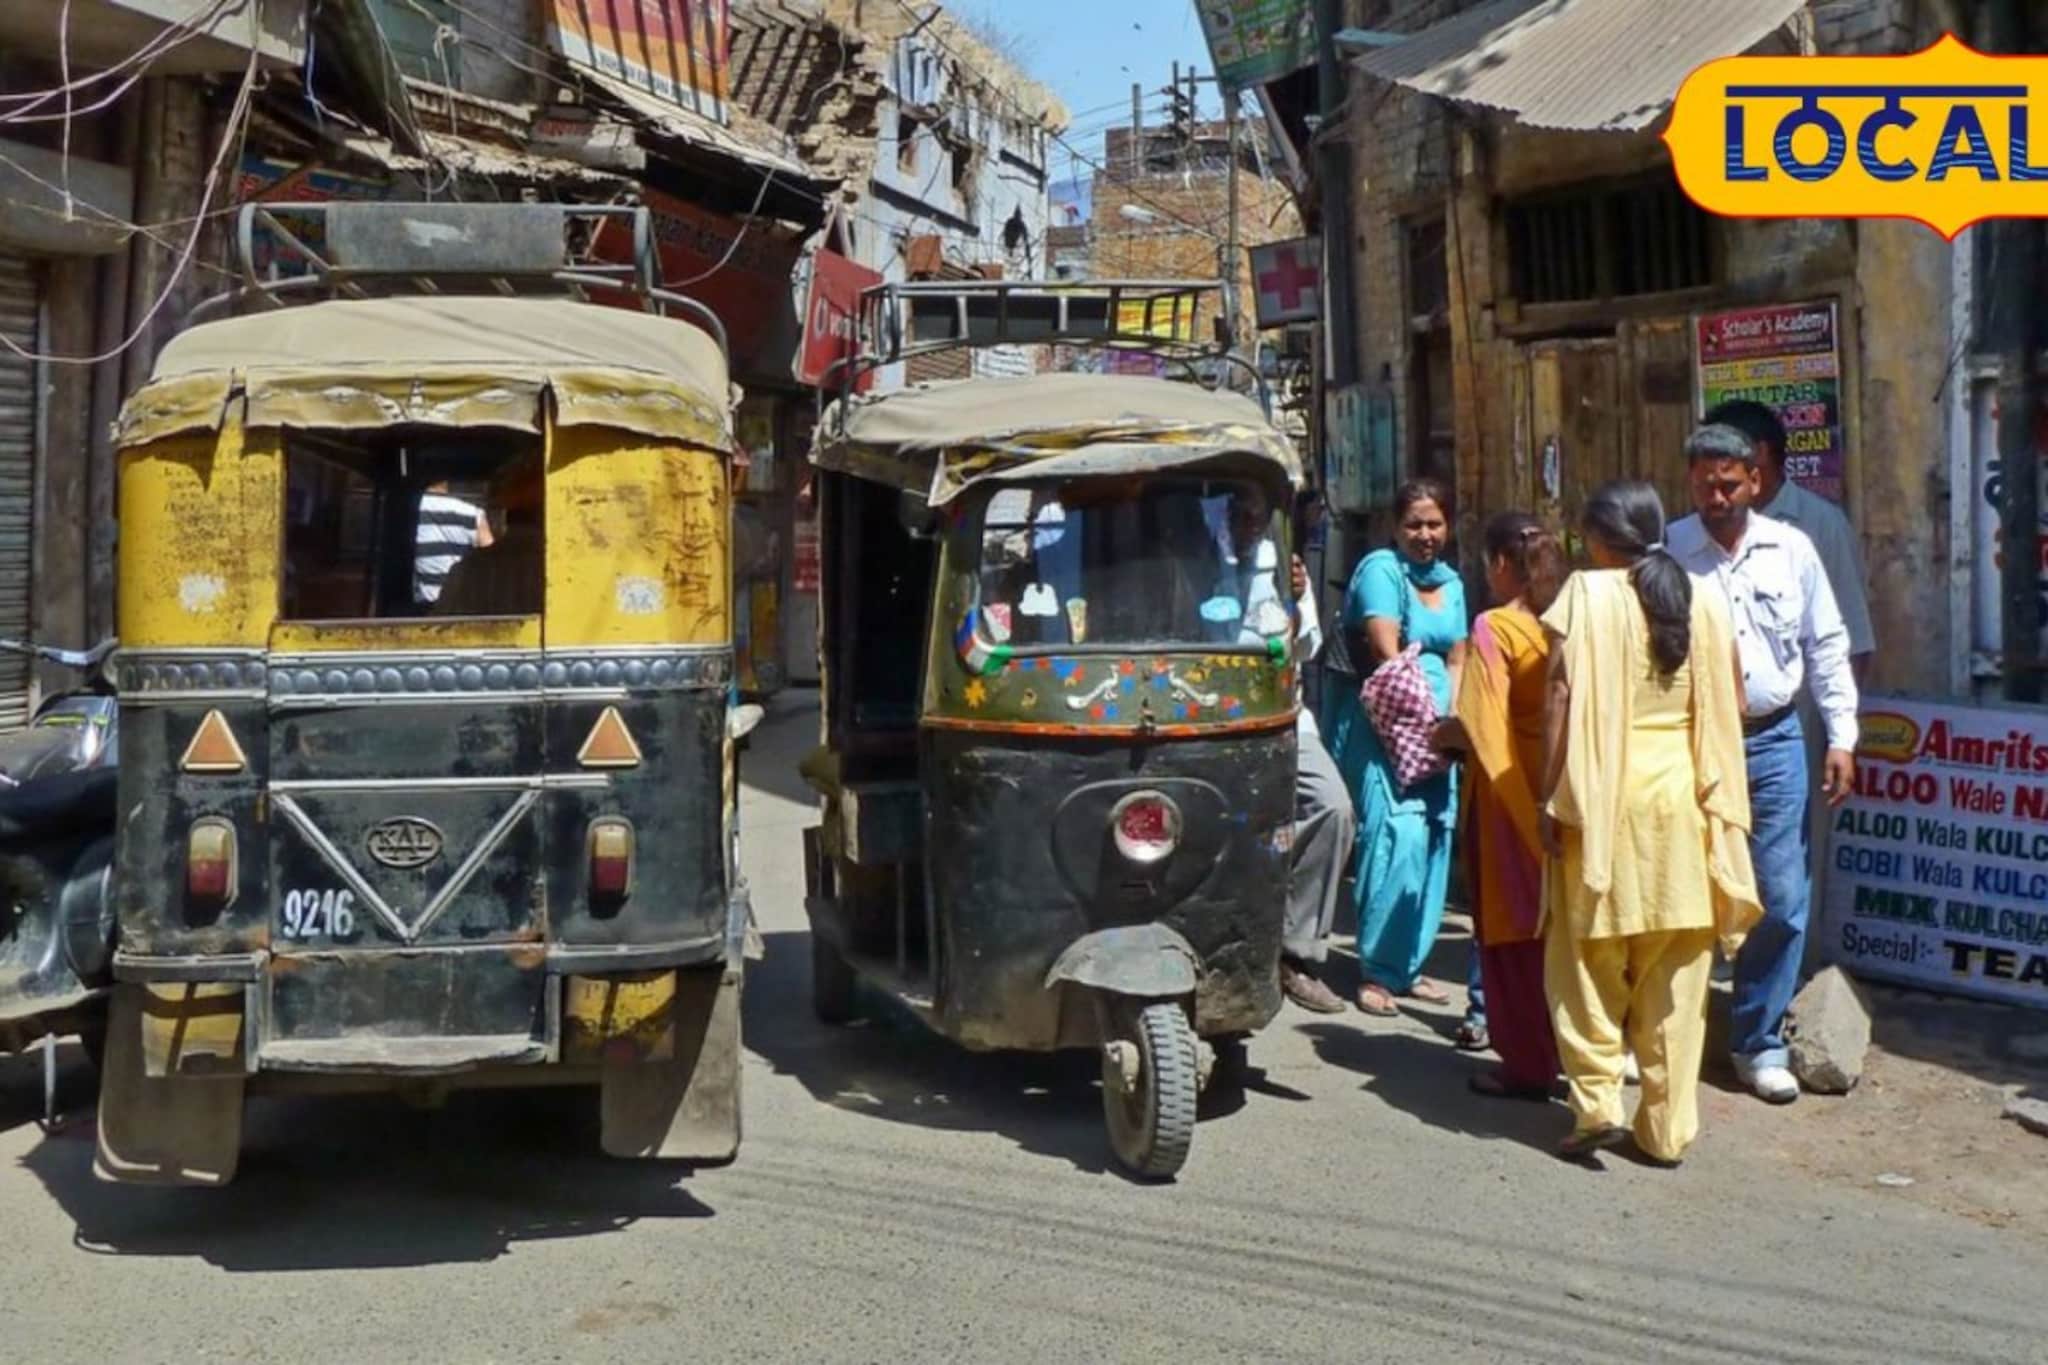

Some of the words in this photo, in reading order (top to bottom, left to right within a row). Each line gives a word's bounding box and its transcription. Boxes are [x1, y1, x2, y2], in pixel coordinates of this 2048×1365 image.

[1775, 310, 1830, 334] Academy
[1783, 456, 1821, 477] SET
[1949, 776, 2006, 815] Wale
[1836, 808, 1907, 841] ALOO
[1916, 817, 1967, 849] Wala
[1975, 826, 2048, 862] KULC
[1836, 846, 1902, 877] GOBI
[1913, 855, 1963, 888] Wala
[1972, 864, 2047, 899] KULC
[284, 889, 354, 937] 9216
[1943, 938, 2048, 986] TEA
